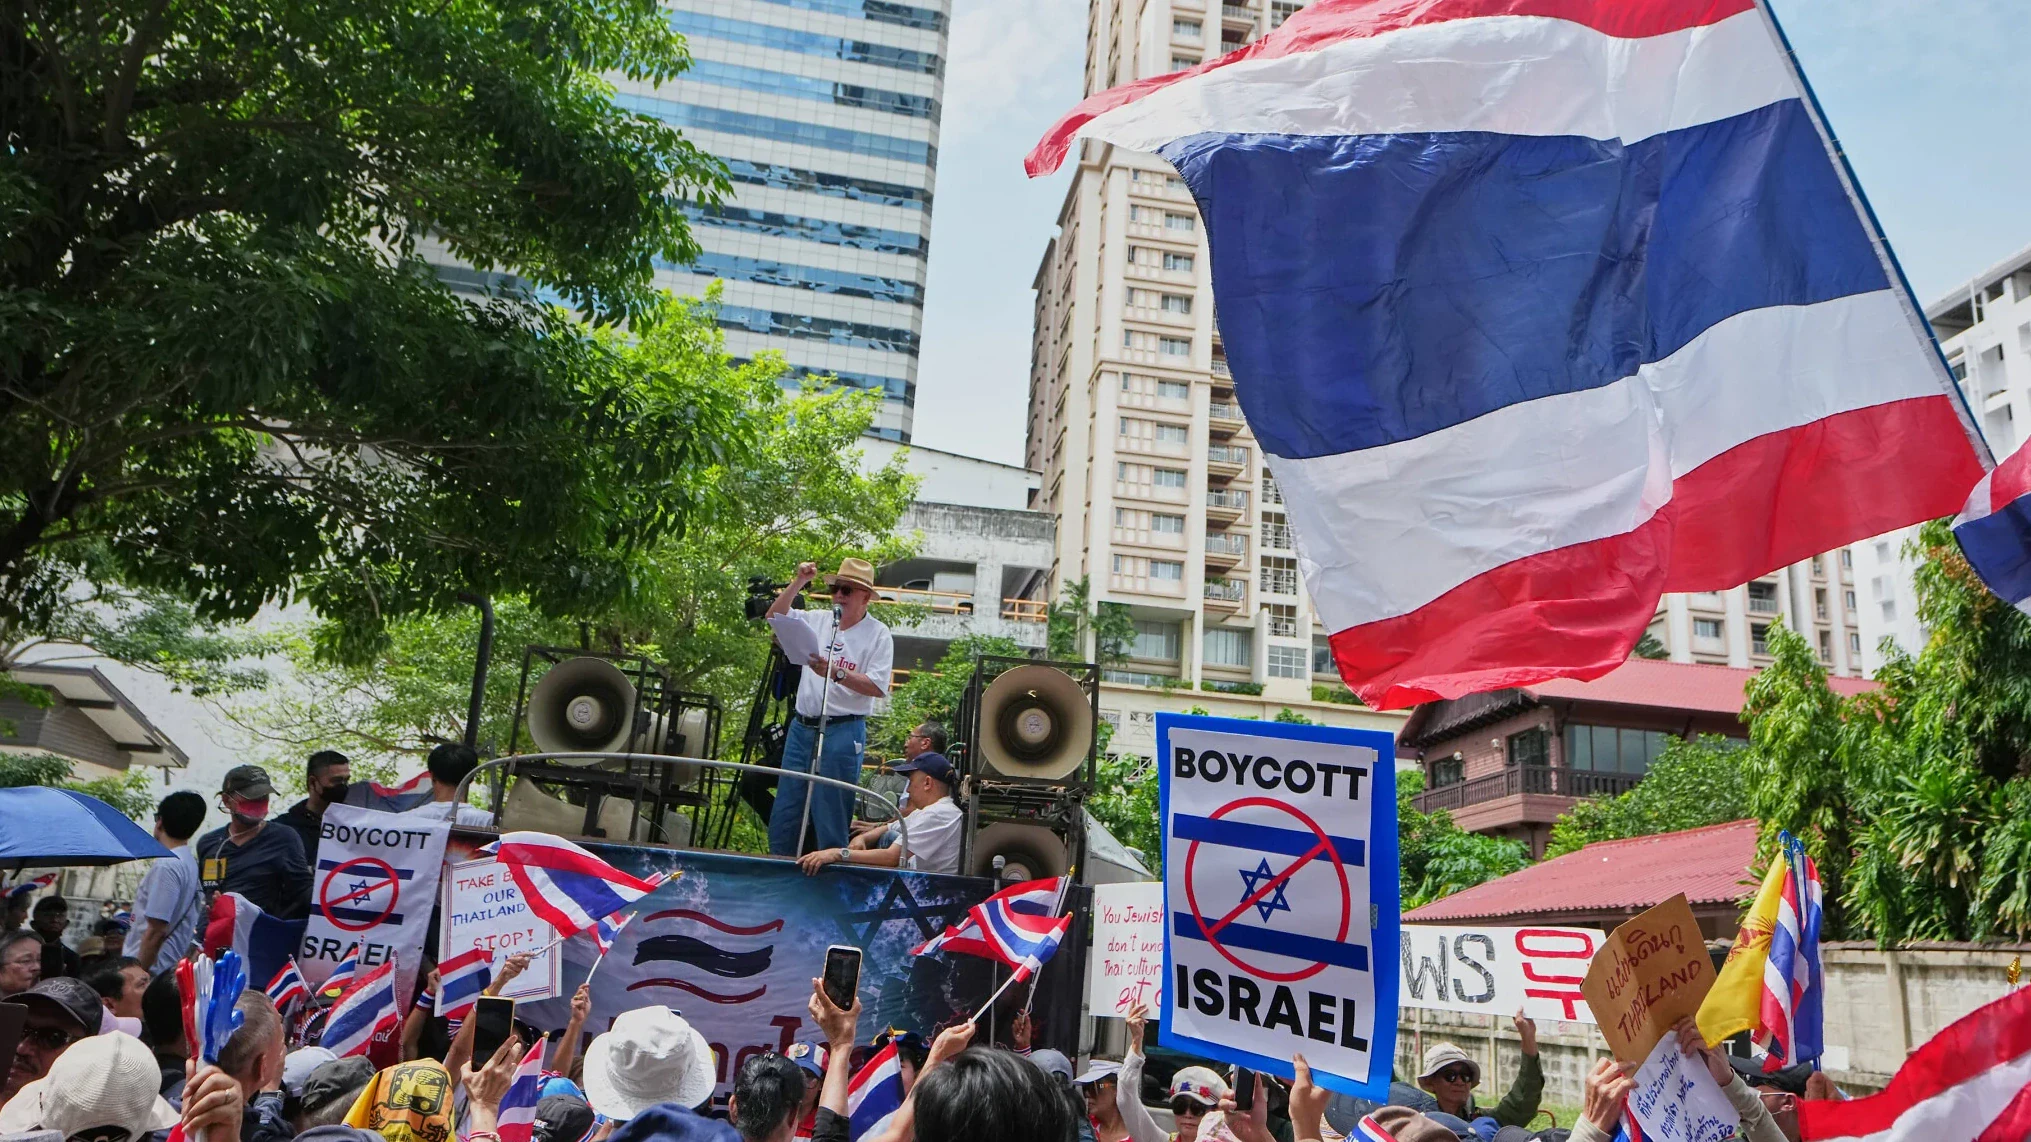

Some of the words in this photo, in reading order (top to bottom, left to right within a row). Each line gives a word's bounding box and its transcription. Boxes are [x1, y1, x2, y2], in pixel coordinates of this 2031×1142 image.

[1174, 747, 1368, 800] BOYCOTT
[320, 822, 431, 850] BOYCOTT
[457, 874, 494, 891] TAKE
[483, 888, 516, 904] OUR
[451, 902, 526, 926] THAILAND
[1108, 933, 1138, 952] don't
[1104, 959, 1125, 976] Thai
[1176, 963, 1368, 1053] ISRAEL
[1617, 959, 1702, 1043] THAILAND
